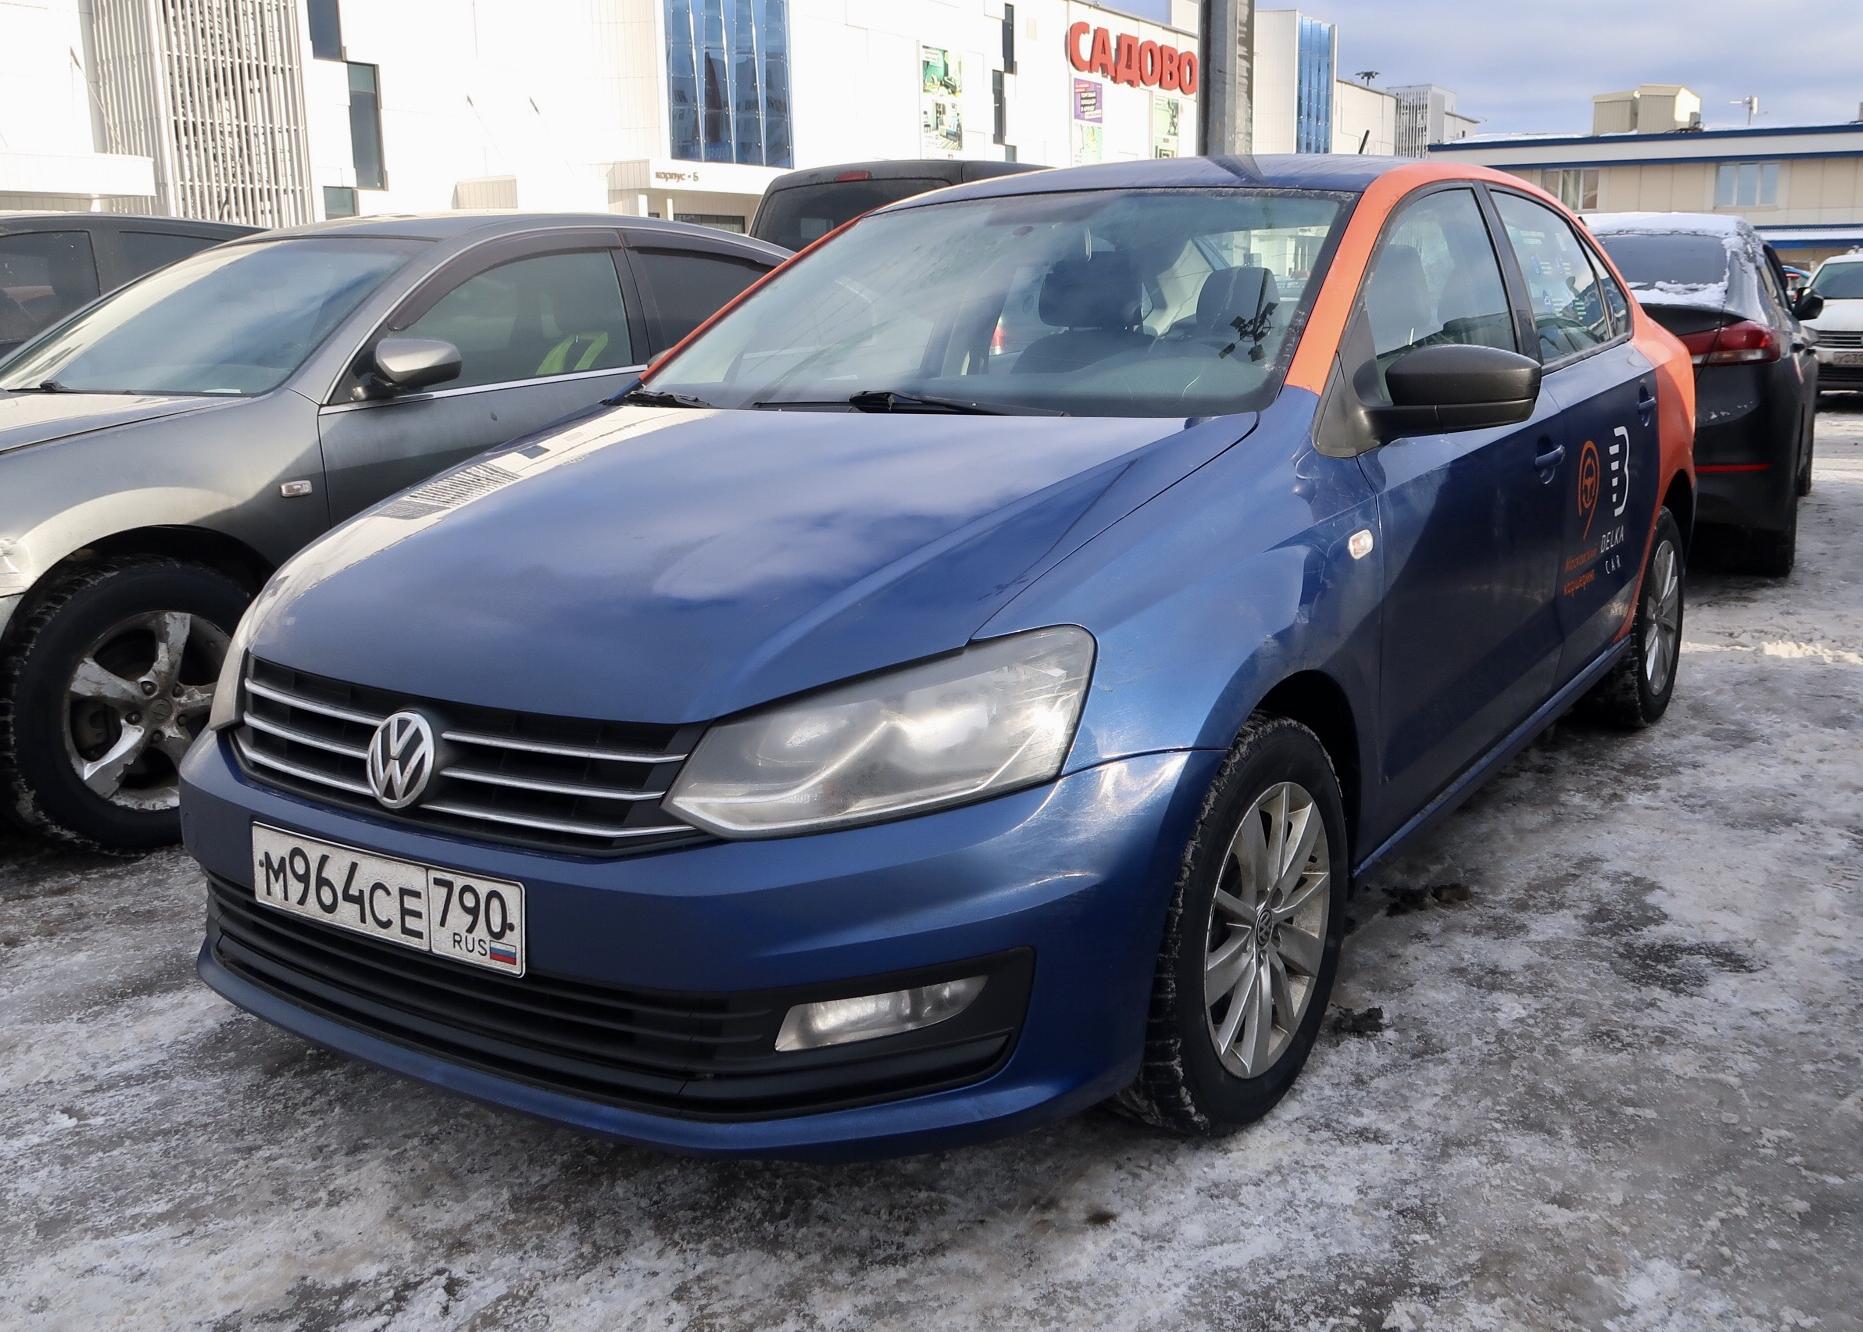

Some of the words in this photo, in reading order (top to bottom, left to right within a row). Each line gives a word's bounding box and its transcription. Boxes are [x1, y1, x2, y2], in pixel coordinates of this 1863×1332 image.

[655, 171, 686, 182] корпус
[433, 877, 509, 941] 790
[452, 932, 488, 957] RUS
